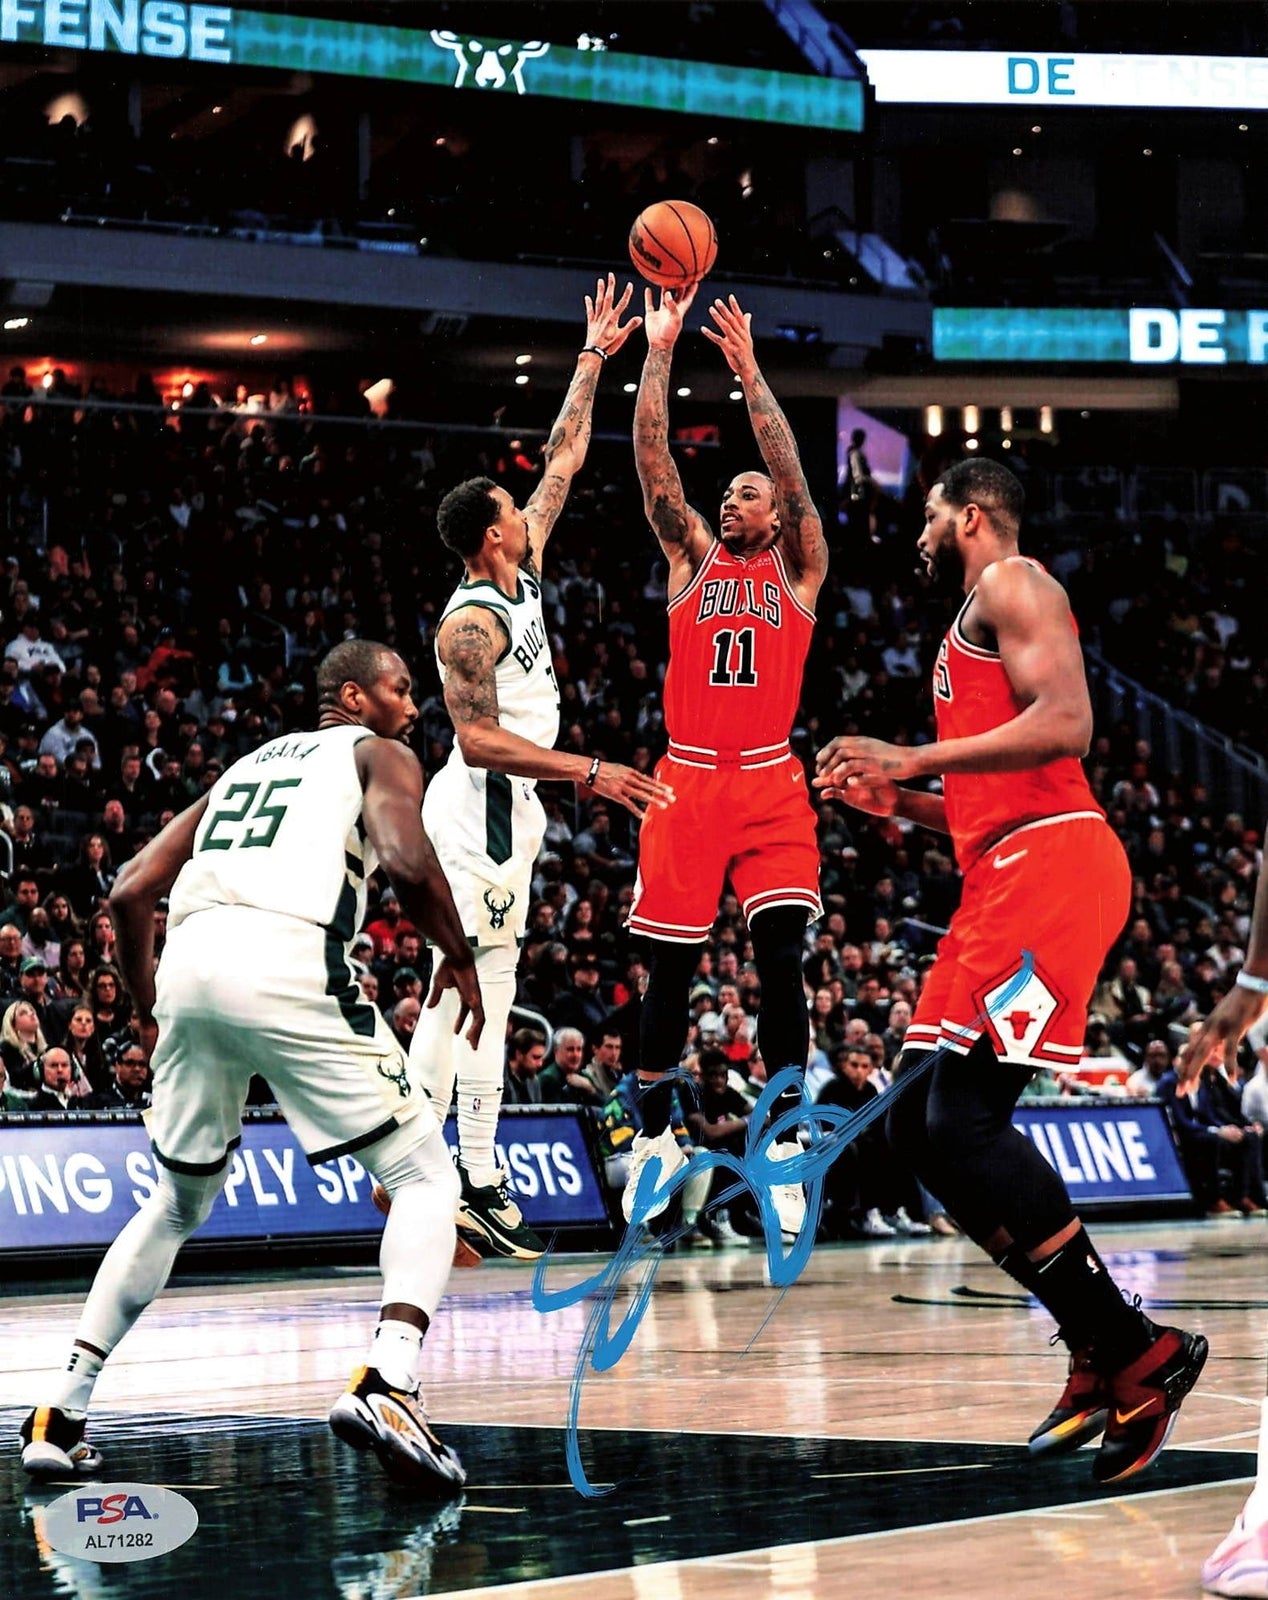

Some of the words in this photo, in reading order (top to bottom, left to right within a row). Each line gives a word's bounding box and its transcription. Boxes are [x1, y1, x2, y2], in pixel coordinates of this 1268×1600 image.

[0, 0, 232, 63] FENSE
[1007, 57, 1076, 95] DE
[1129, 307, 1227, 364] DE
[709, 626, 758, 687] 11
[199, 777, 302, 852] 25
[0, 1151, 113, 1216] ING
[125, 1148, 298, 1208] SPLY
